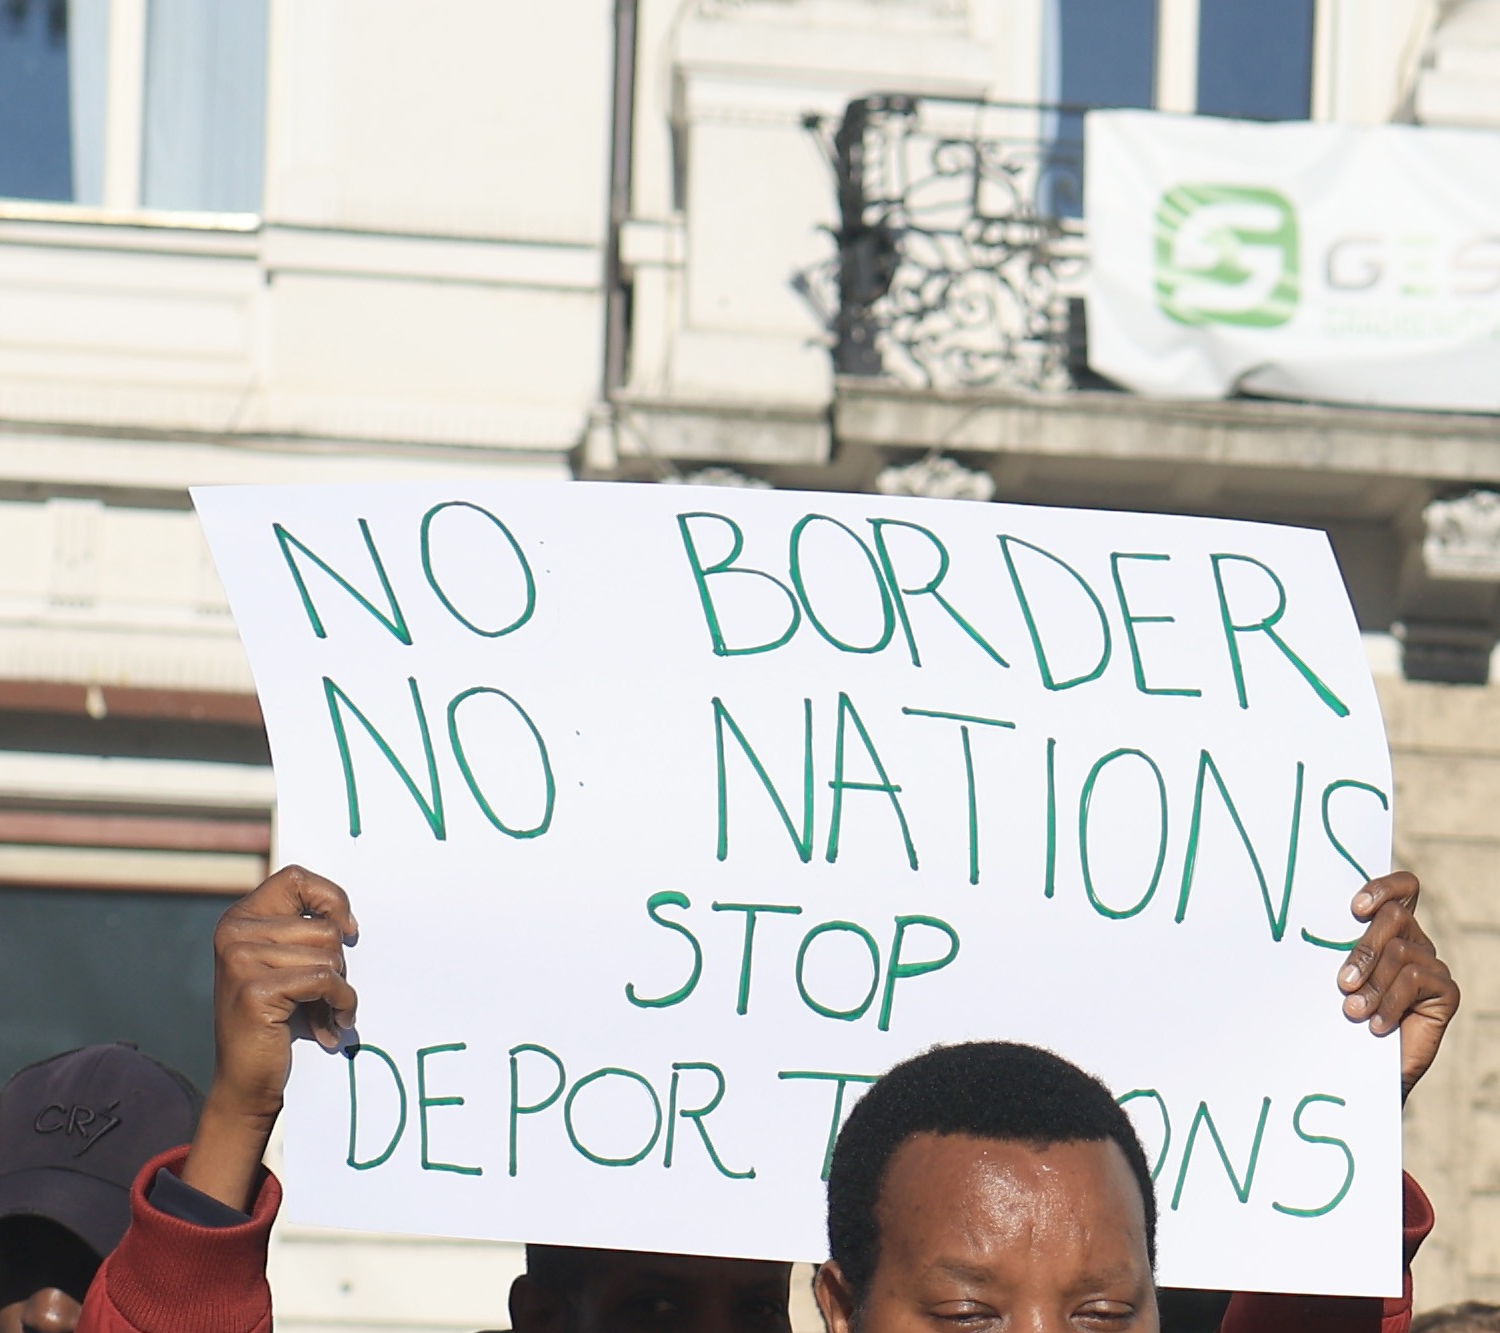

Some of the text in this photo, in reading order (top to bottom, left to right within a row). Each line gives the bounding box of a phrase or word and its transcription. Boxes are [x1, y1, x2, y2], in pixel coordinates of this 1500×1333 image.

[272, 501, 1350, 717] NO BORDER
[322, 676, 1390, 951] NO NATIONS
[625, 890, 960, 1032] STOP
[340, 1035, 1358, 1222] DEPORTONS
